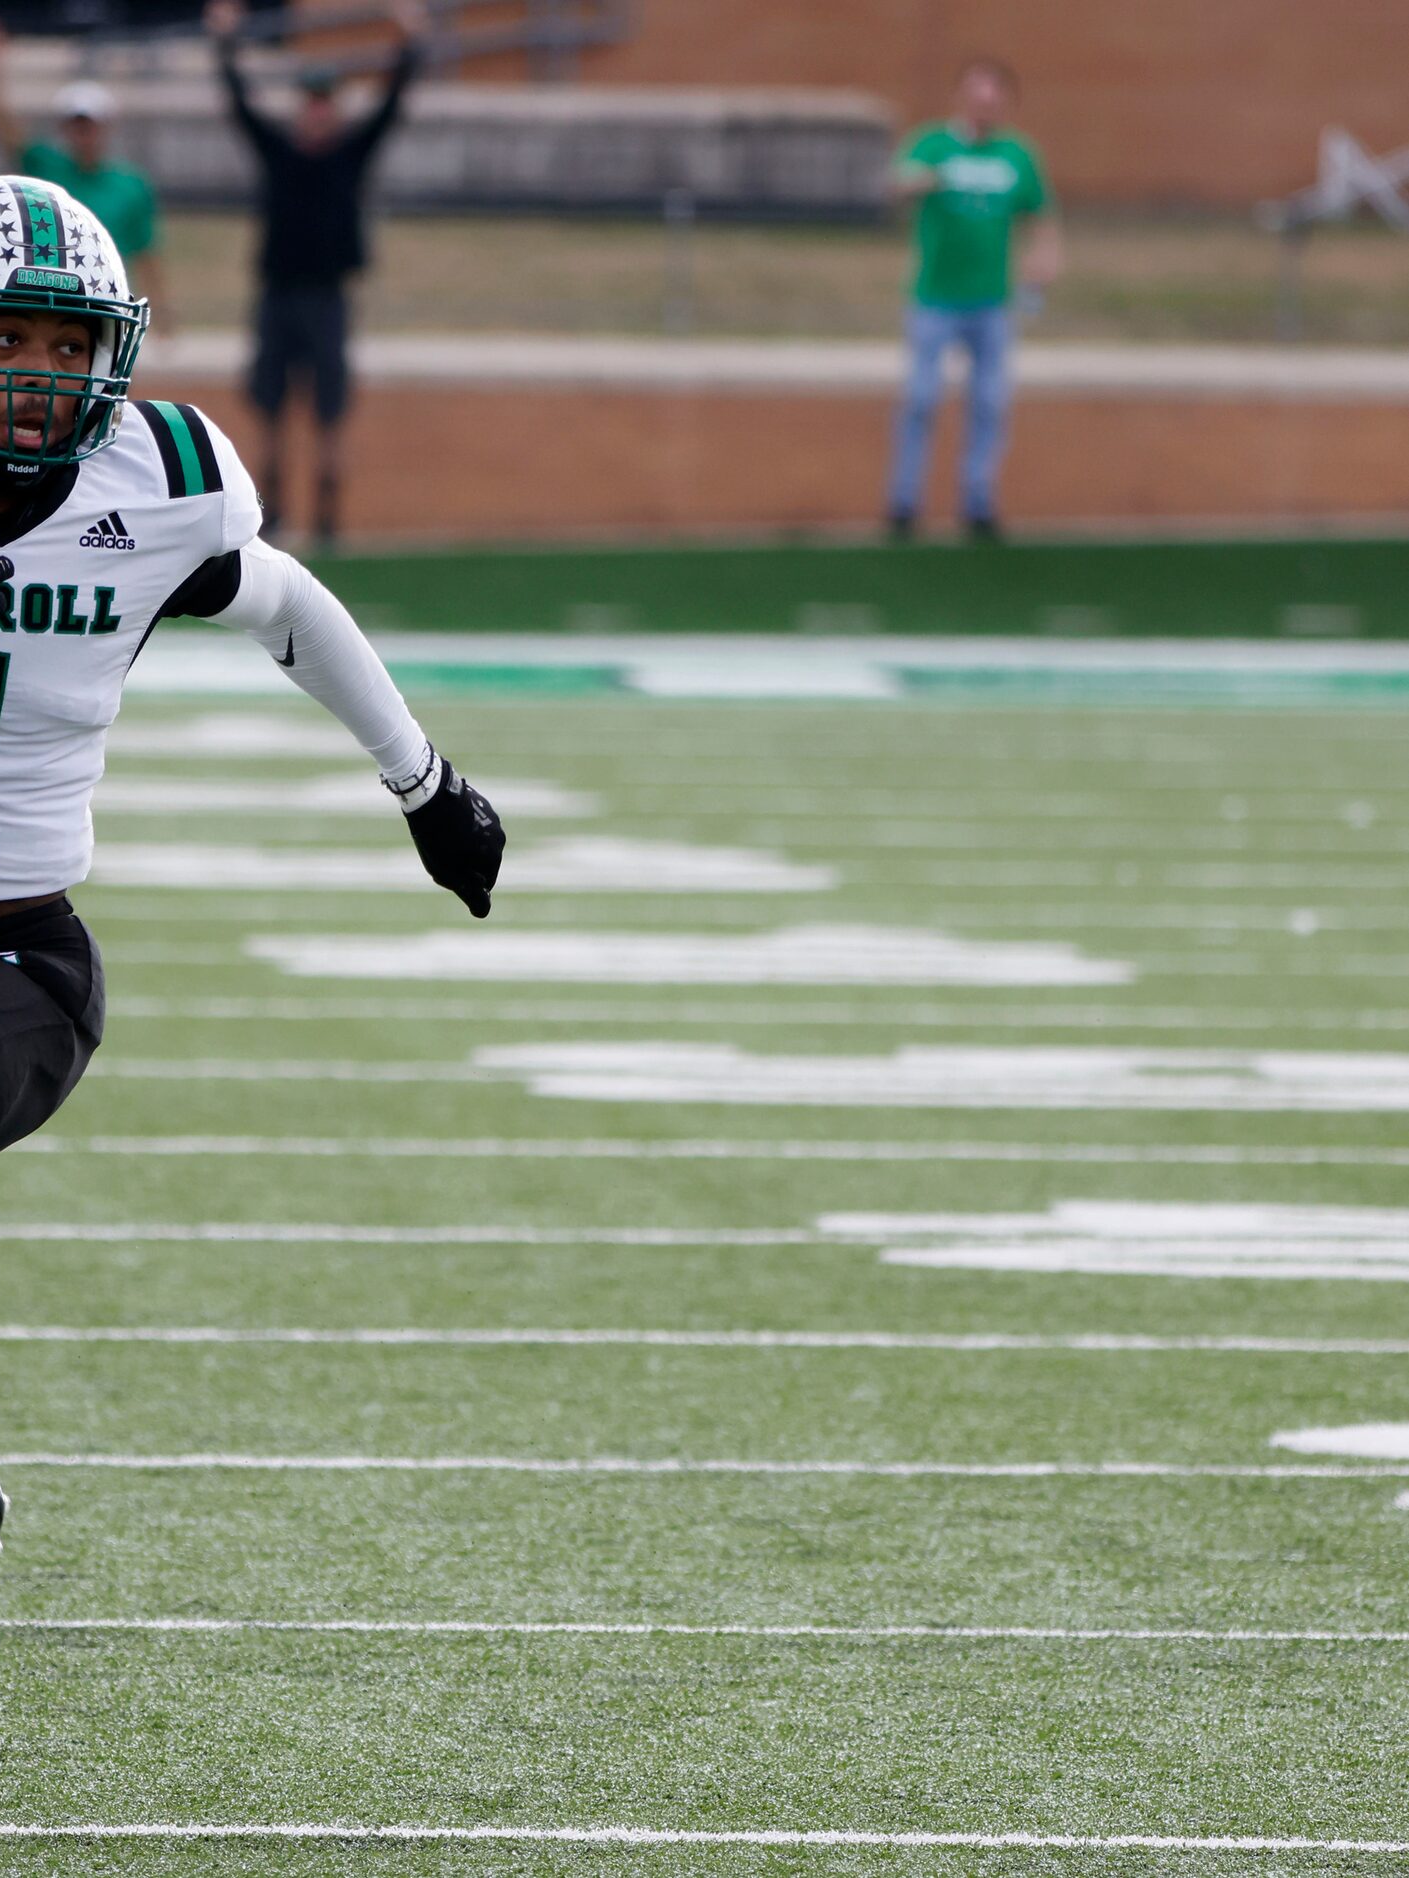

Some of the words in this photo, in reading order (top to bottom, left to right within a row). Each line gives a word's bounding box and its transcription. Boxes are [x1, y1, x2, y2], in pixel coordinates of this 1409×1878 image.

[16, 269, 79, 291] DRAGONS
[7, 463, 39, 473] Riddell
[79, 534, 135, 550] adidas
